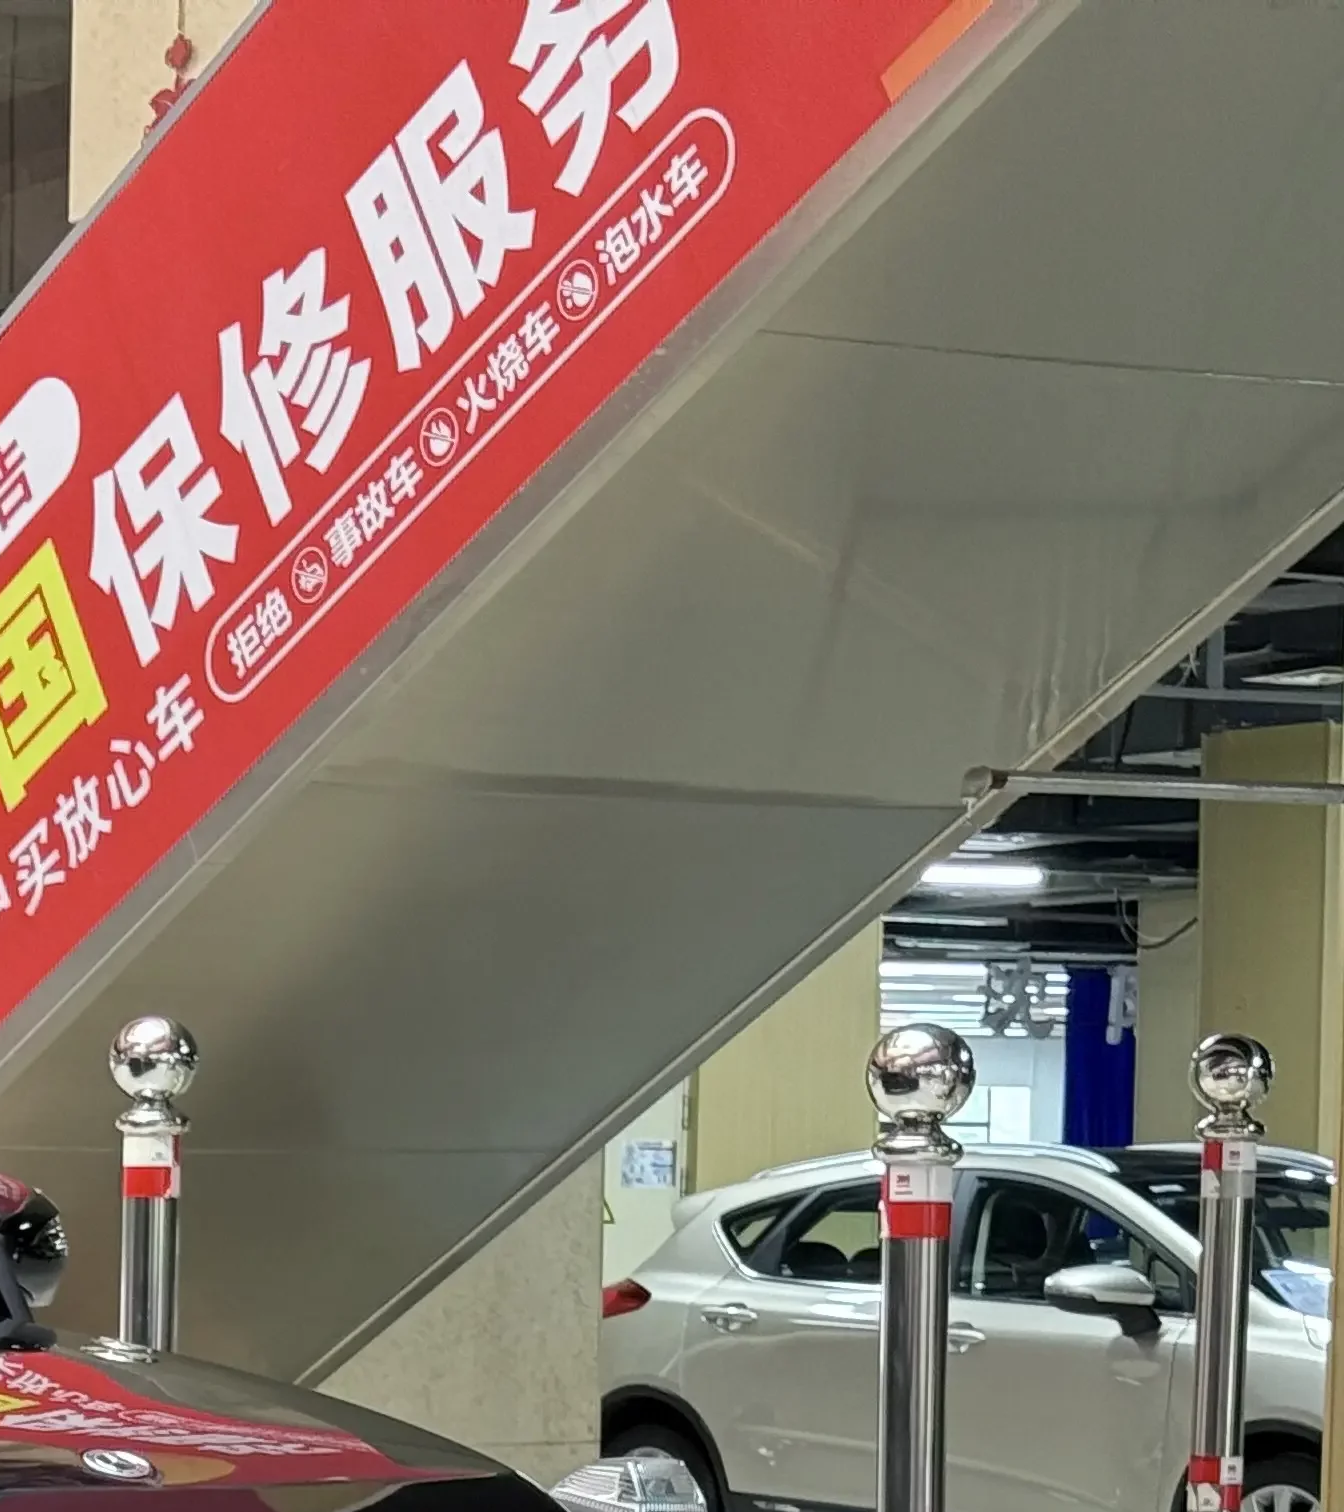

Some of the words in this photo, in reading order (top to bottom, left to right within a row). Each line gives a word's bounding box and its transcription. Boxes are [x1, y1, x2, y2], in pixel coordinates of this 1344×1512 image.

[226, 587, 292, 679] 拒绝
[323, 447, 423, 568] 事故车
[457, 303, 560, 433] 火烧车
[595, 144, 708, 286] 泡水车
